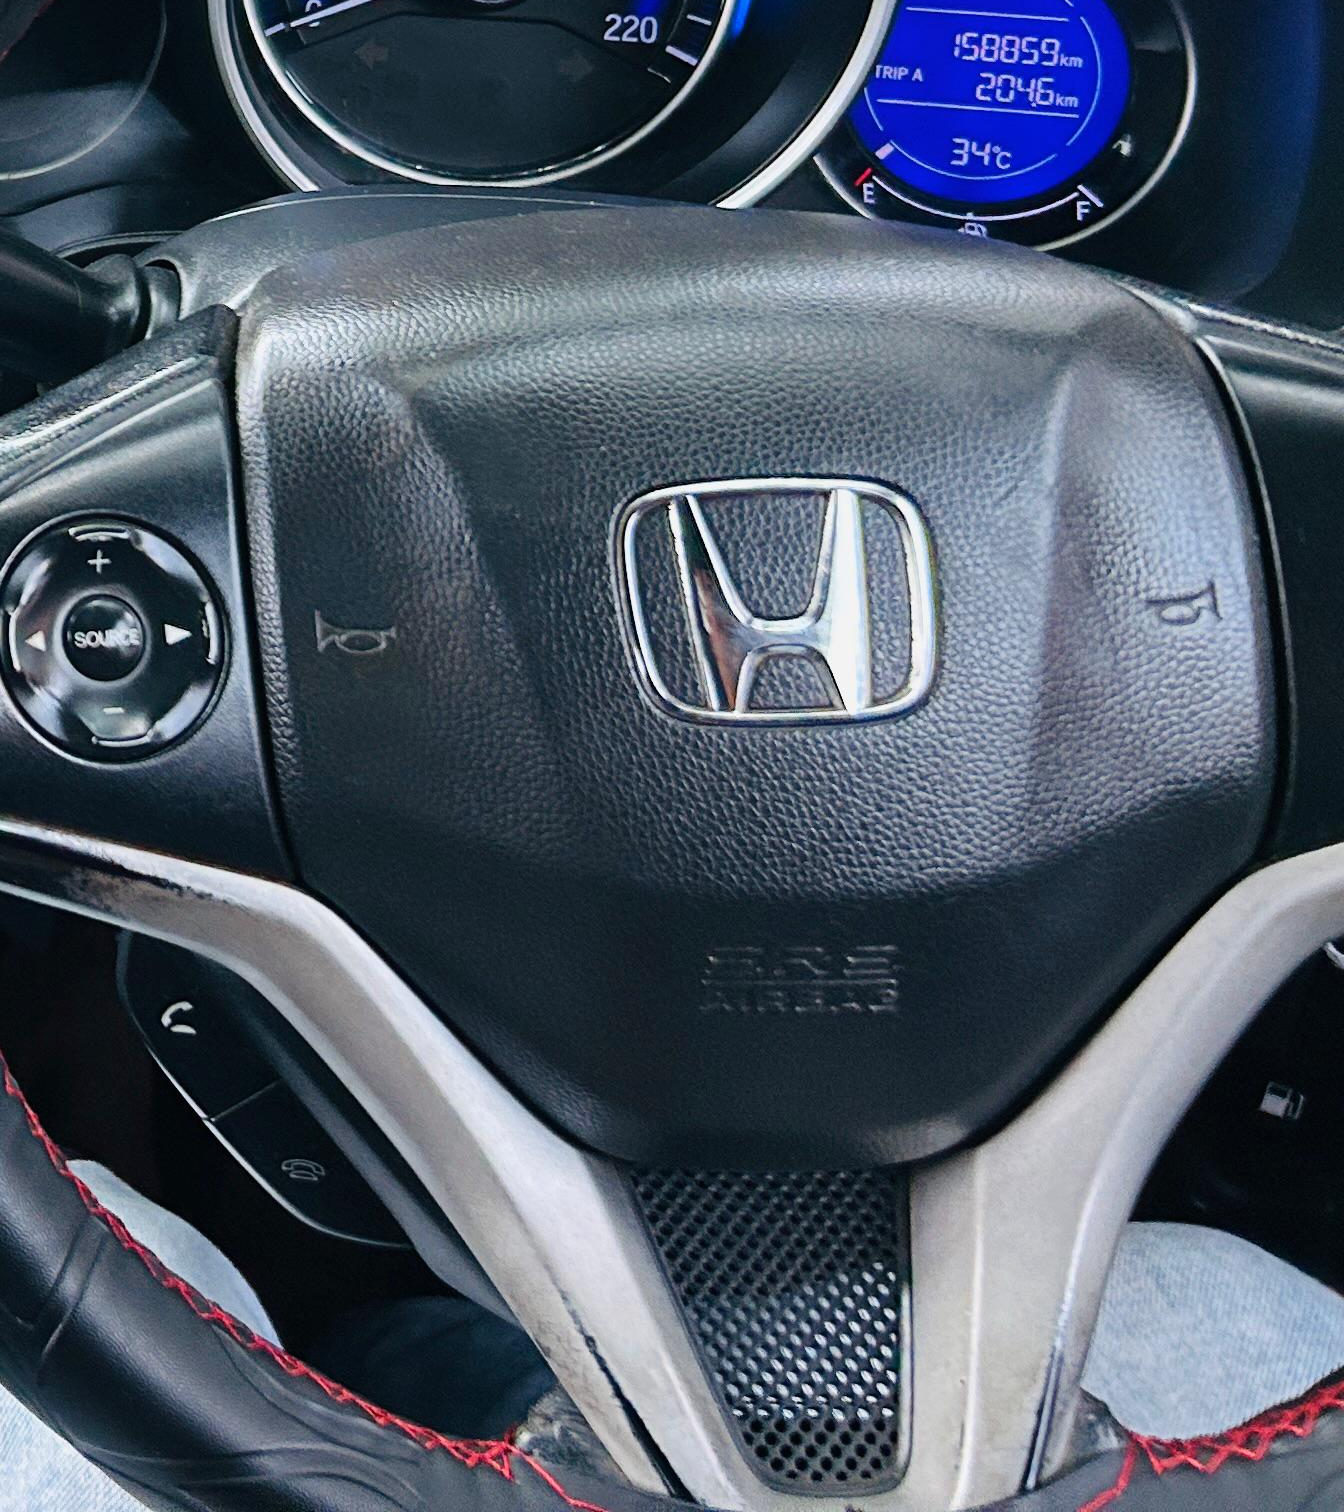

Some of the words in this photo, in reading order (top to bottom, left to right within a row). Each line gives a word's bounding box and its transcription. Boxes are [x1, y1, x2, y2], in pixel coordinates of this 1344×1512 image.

[603, 14, 658, 44] 220
[875, 64, 910, 81] TRIP
[912, 67, 924, 82] A
[862, 182, 874, 204] E
[1076, 200, 1091, 222] F
[74, 630, 141, 648] SOURCE
